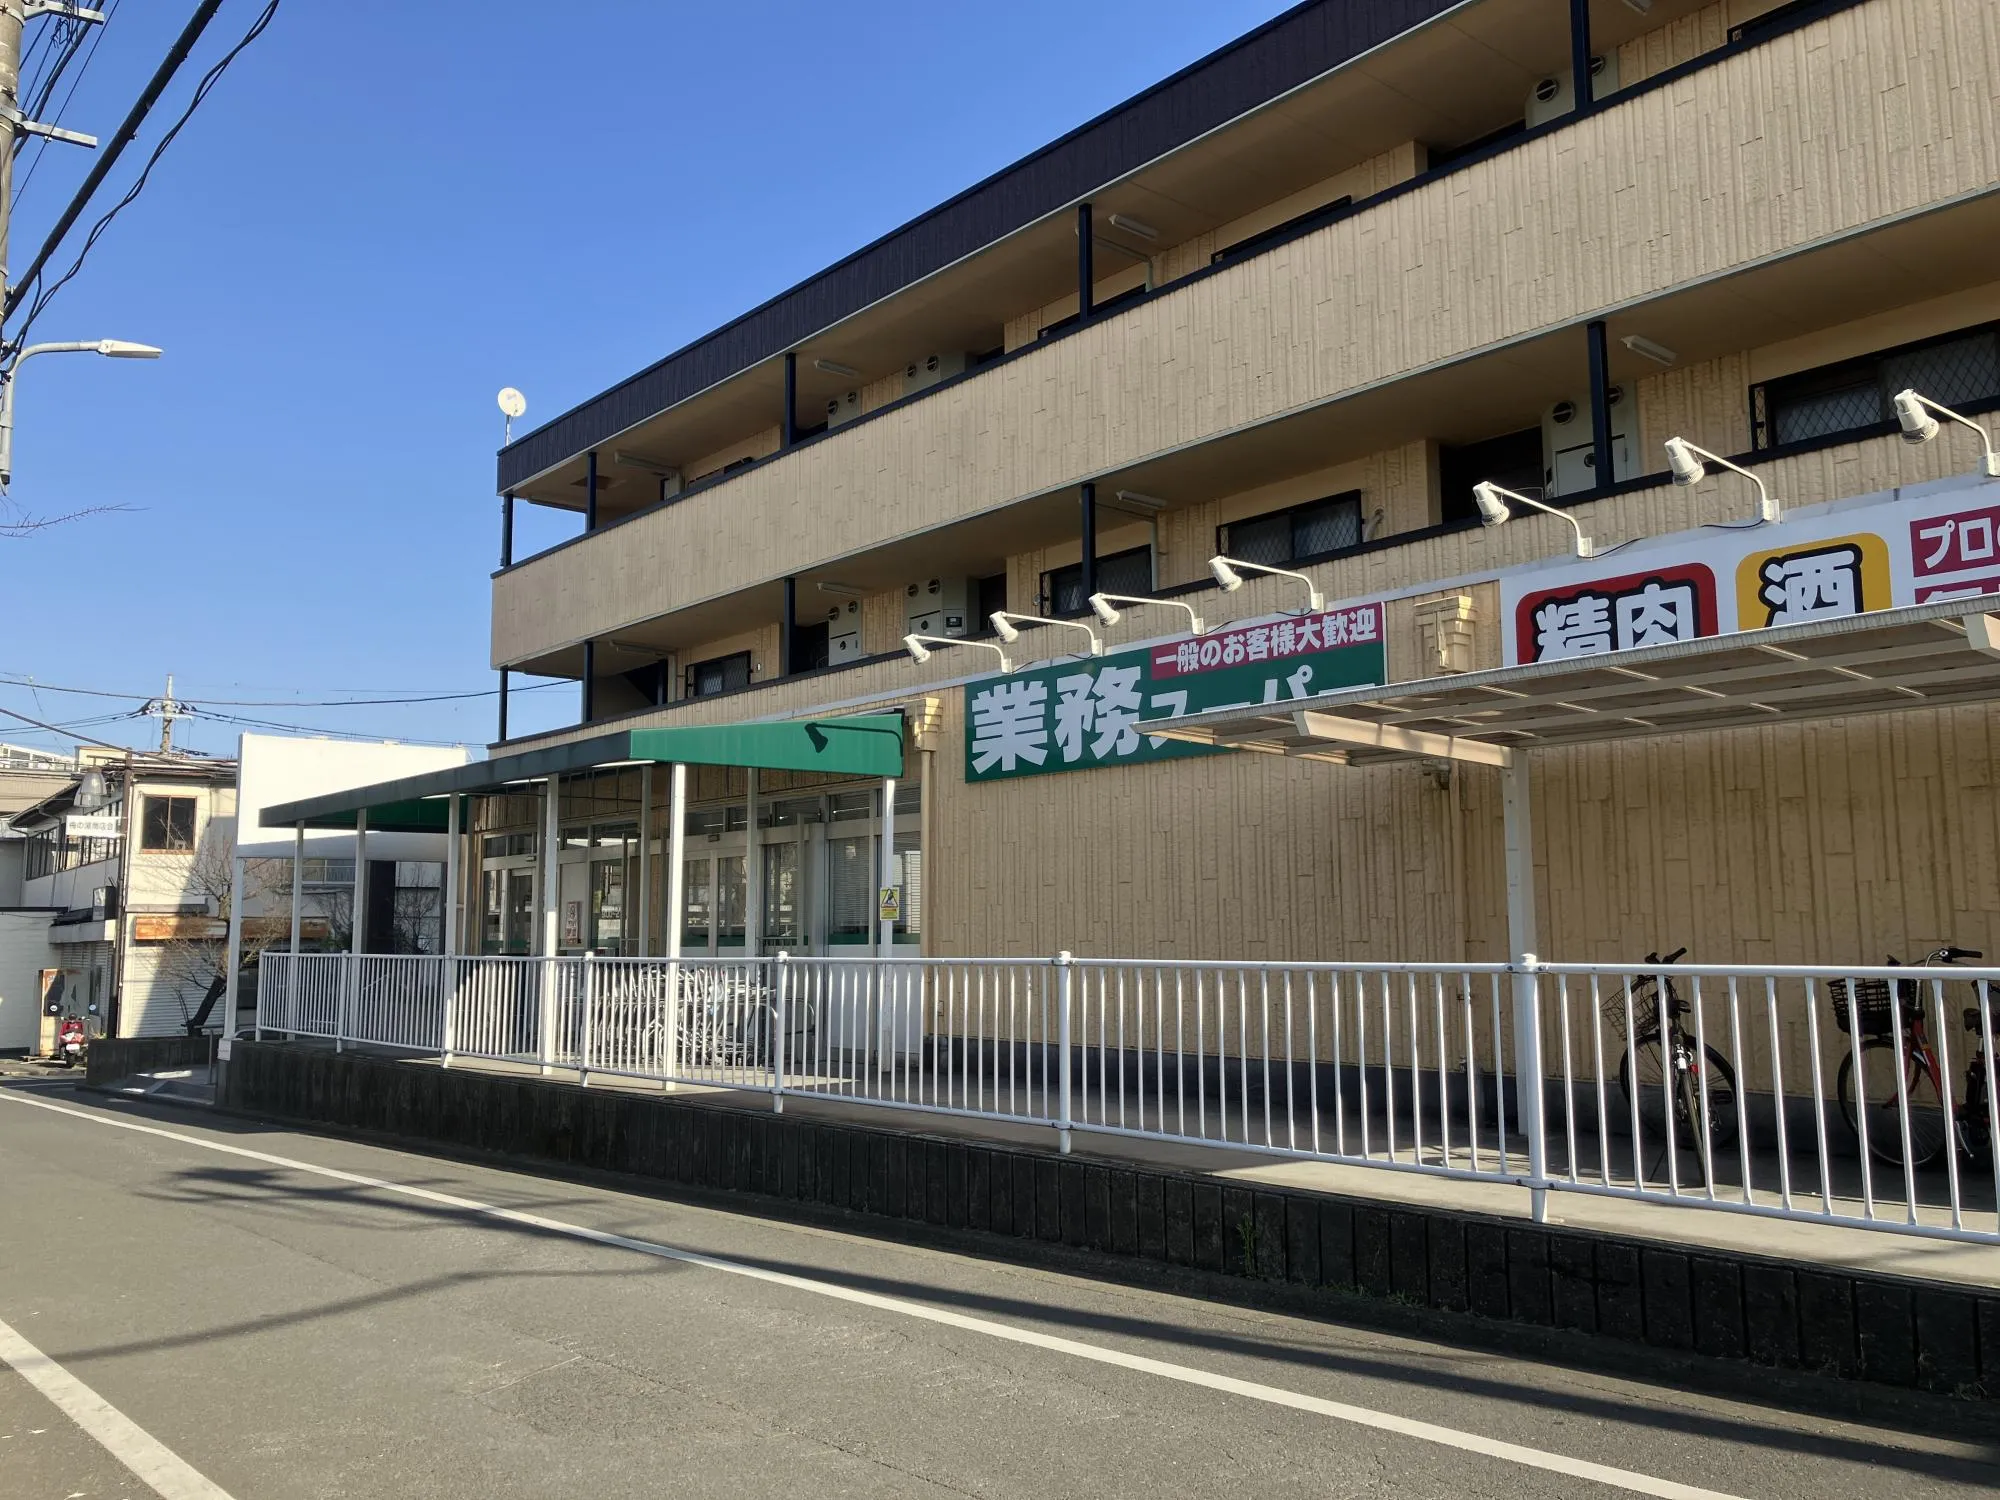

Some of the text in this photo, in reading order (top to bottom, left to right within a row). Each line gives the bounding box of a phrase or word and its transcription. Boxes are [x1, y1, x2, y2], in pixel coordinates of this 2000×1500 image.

[1919, 517, 2000, 569] プロ
[1536, 583, 1694, 661] 精肉
[1764, 550, 1855, 626] 酒
[1155, 607, 1377, 673] 一般のお客様大歓迎
